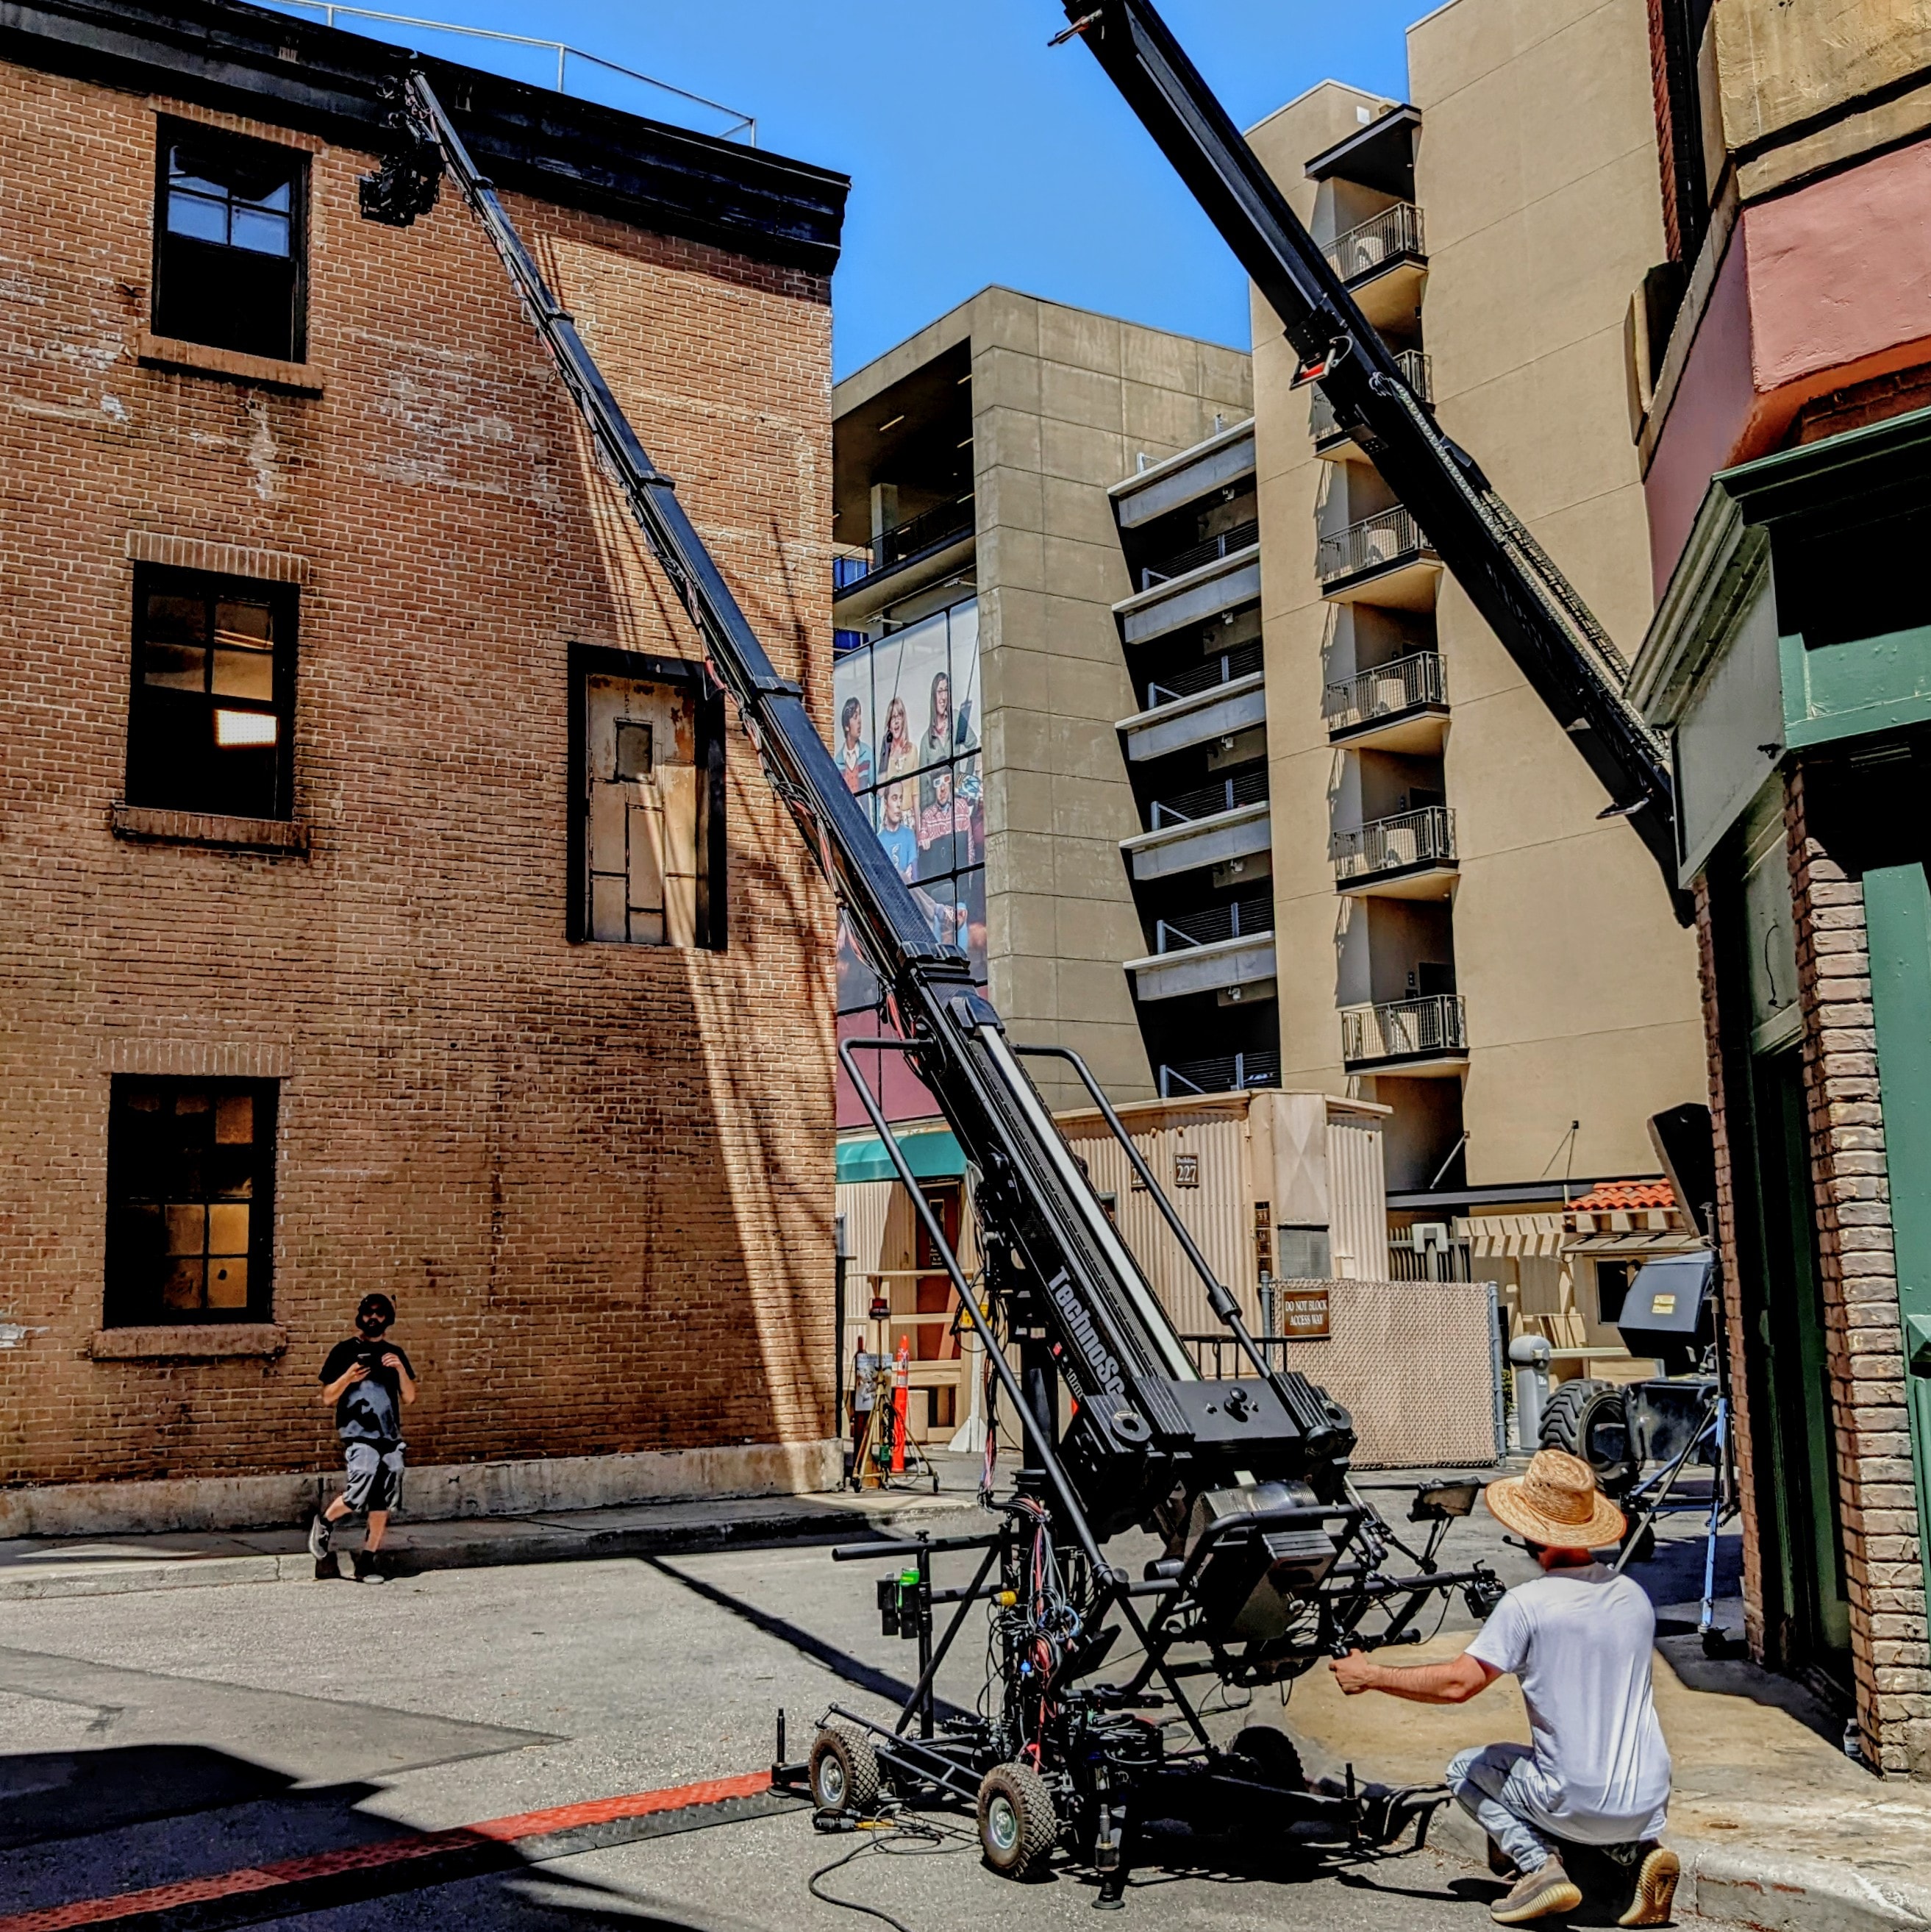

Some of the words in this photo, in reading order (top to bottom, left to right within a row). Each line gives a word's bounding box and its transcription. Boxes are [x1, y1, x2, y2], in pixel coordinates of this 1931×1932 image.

[1177, 1165, 1197, 1183] 227
[1285, 1300, 1294, 1311] DO
[1295, 1300, 1307, 1311] NOT
[1308, 1300, 1327, 1311] BLOCK
[1290, 1314, 1310, 1326] ACCESS
[1311, 1313, 1324, 1325] WAY
